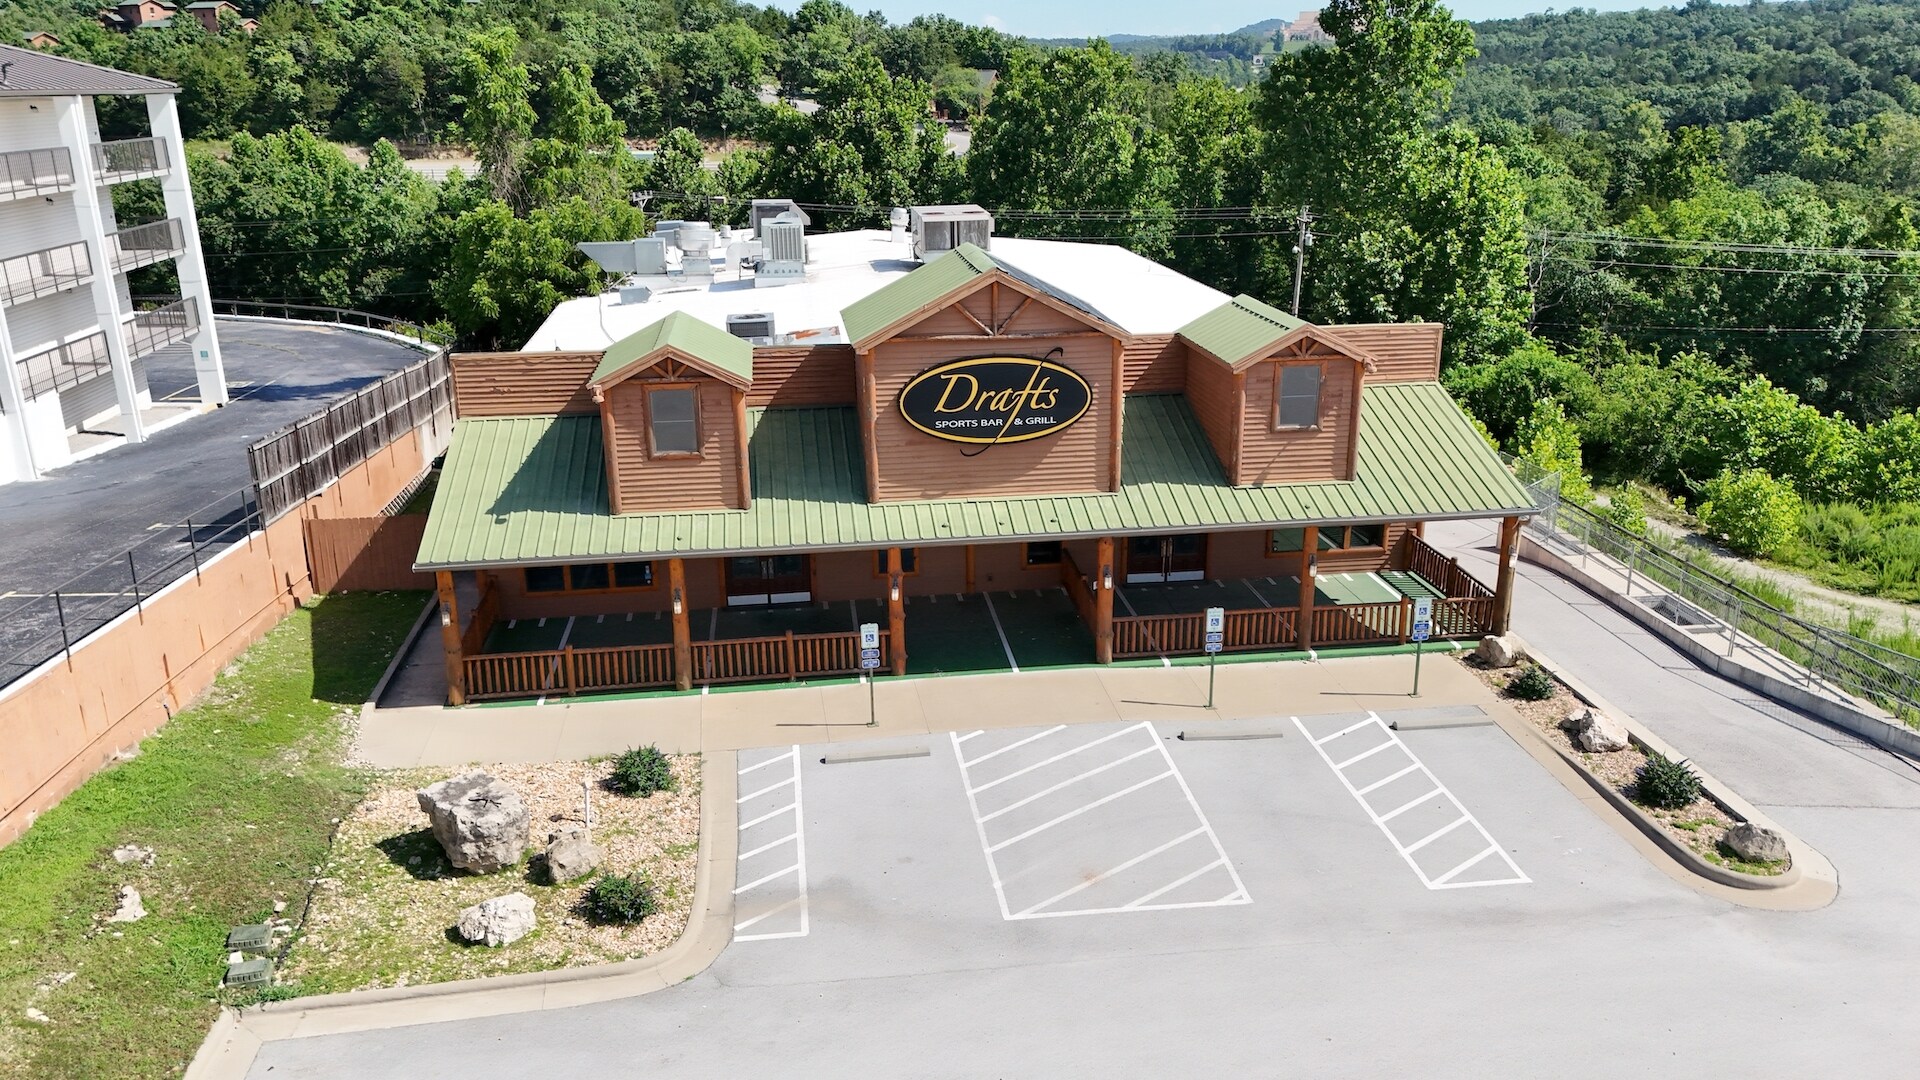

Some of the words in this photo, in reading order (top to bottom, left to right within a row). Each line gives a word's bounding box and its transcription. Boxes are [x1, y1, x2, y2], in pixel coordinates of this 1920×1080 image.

[933, 364, 1061, 434] Drafts
[935, 419, 979, 429] SPORTS
[980, 418, 1003, 427] BAR
[1014, 417, 1023, 426] &
[1025, 416, 1057, 425] GRILL
